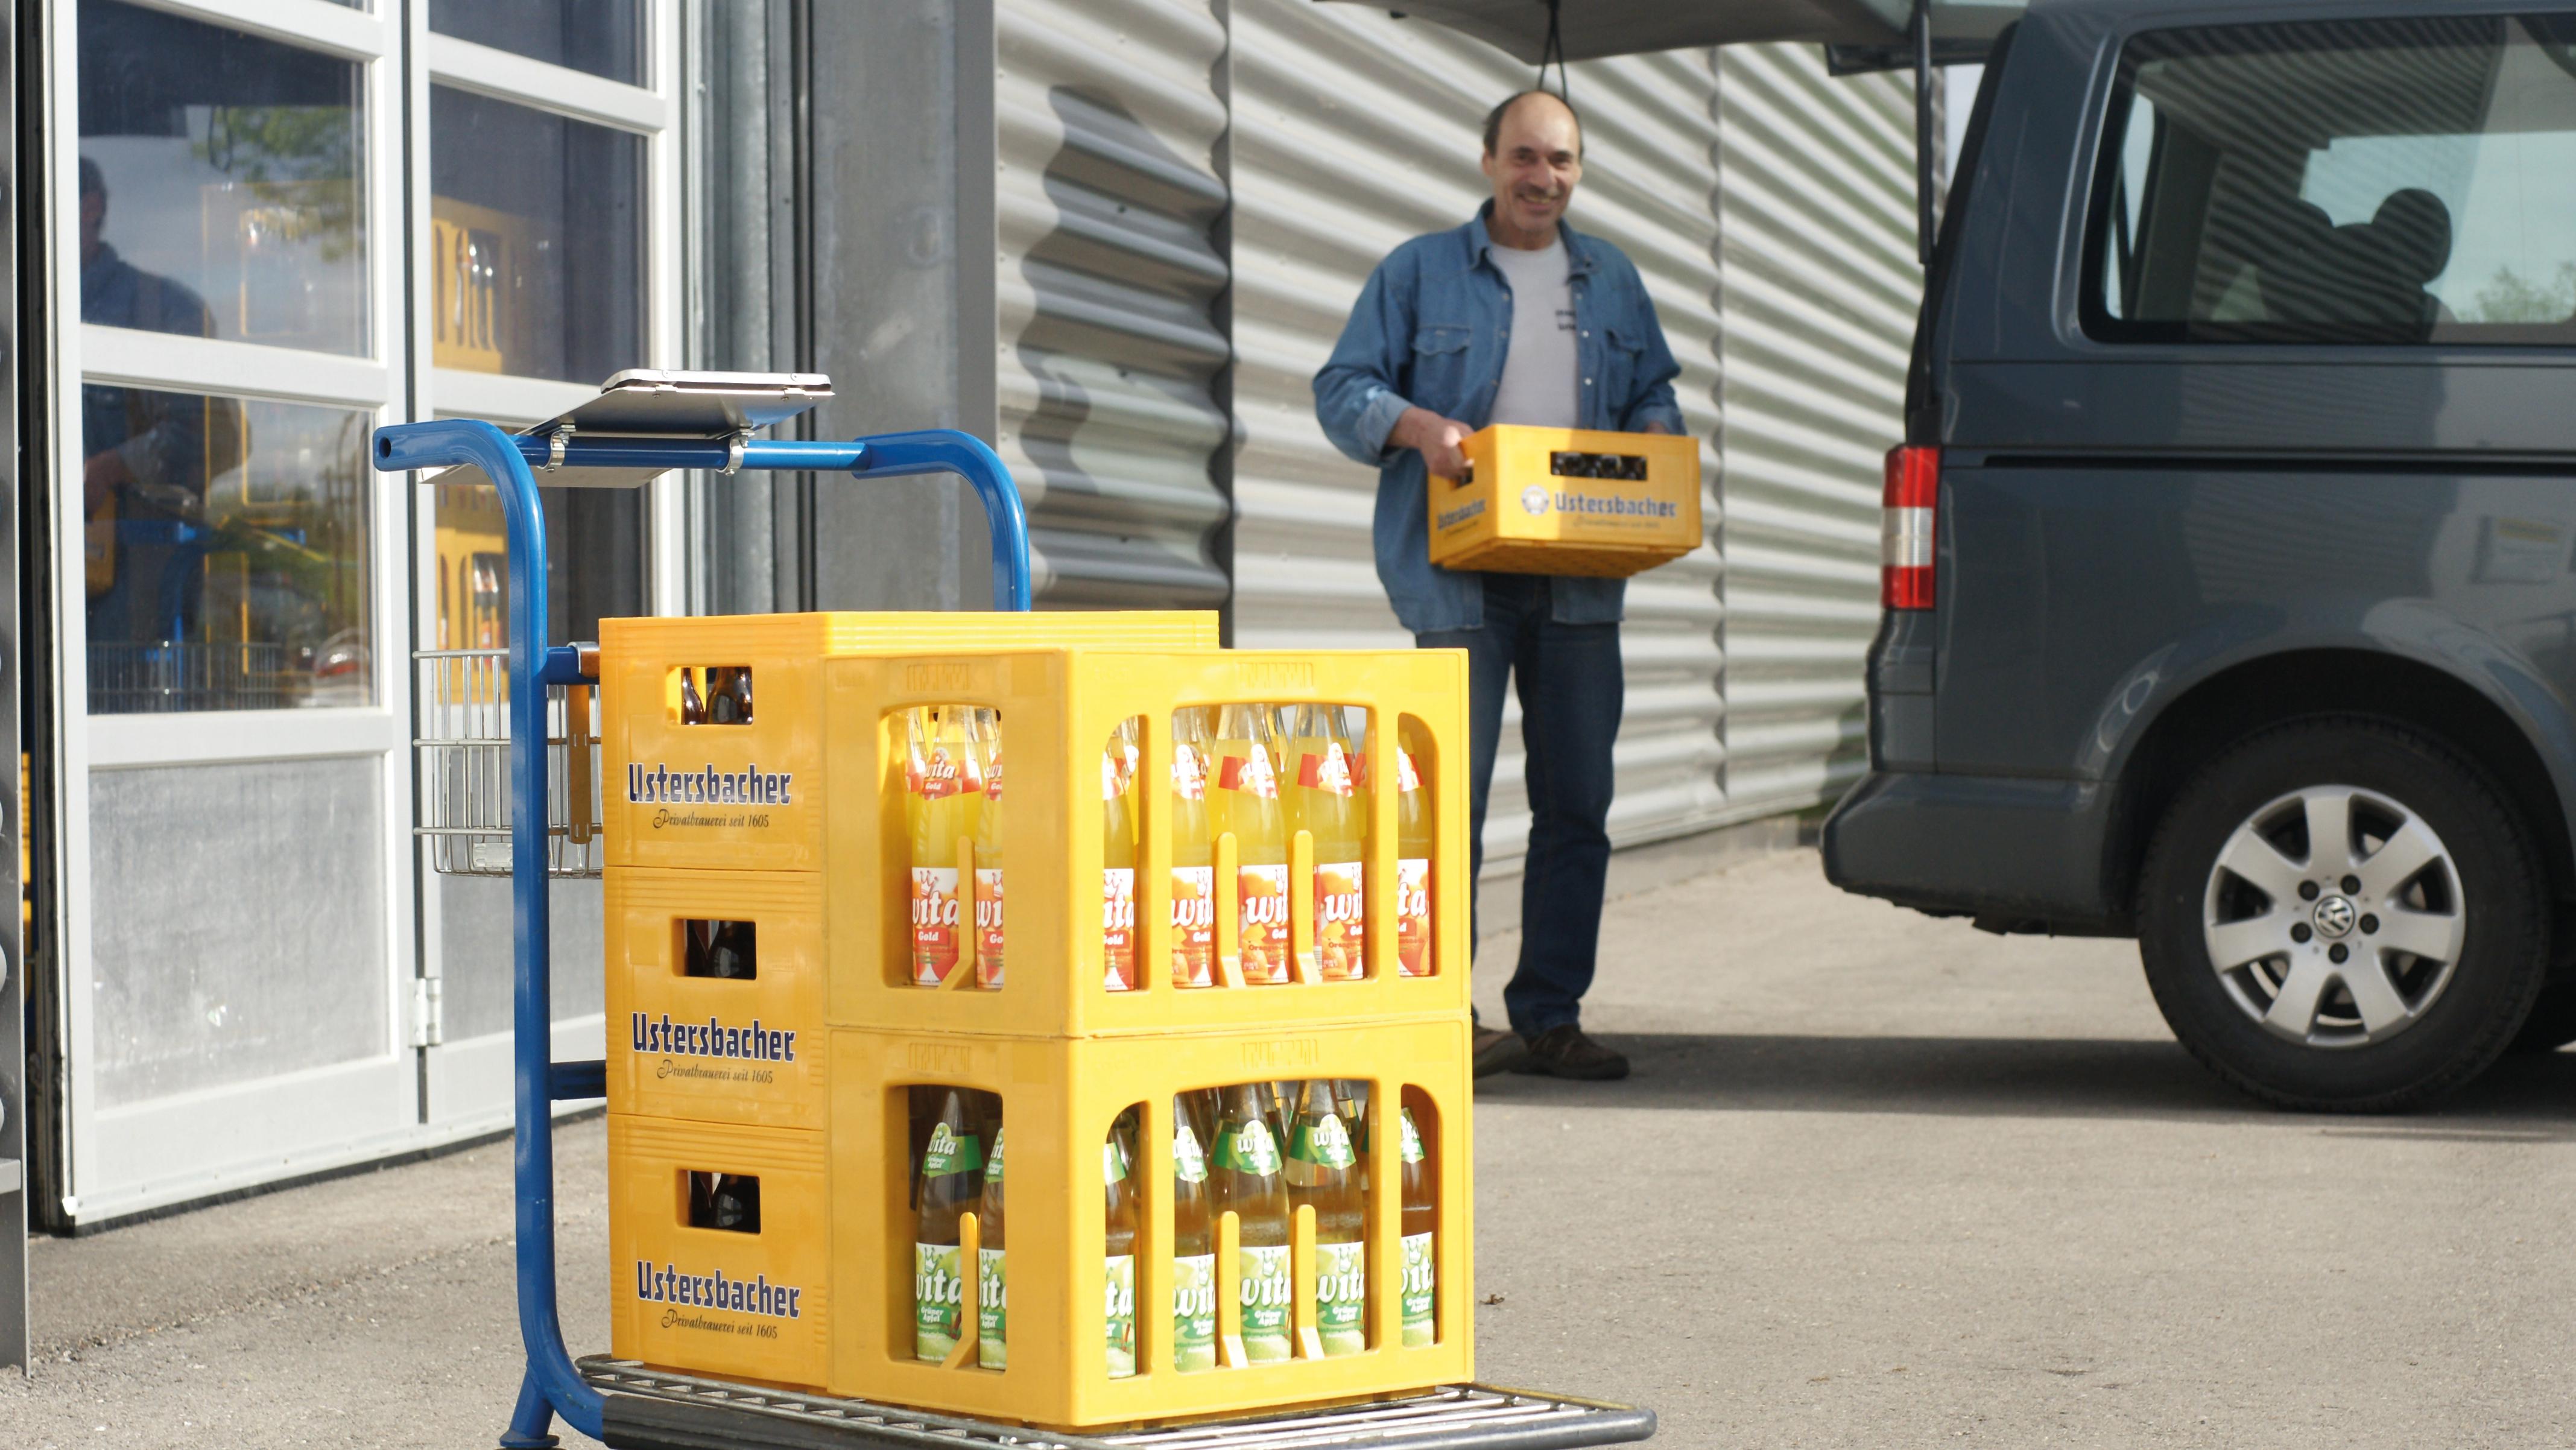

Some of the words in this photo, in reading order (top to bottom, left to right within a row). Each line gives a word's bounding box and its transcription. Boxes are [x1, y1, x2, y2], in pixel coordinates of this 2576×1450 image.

[1554, 492, 1677, 518] Ustersbacher
[628, 762, 793, 805] Ustersbacher
[653, 809, 727, 829] Privatbrauerei
[729, 815, 745, 827] seit
[748, 814, 769, 828] 1605
[976, 901, 1003, 927] wi
[1104, 893, 1134, 928] ita
[1398, 882, 1427, 917] ta
[918, 931, 939, 941] Gold
[990, 934, 1003, 943] Go
[632, 1012, 796, 1062] Ustersbacher
[657, 1059, 730, 1080] Privatbrauerei
[733, 1069, 749, 1081] seit
[752, 1069, 773, 1084] 1605
[637, 1260, 800, 1319] Ustersbacher
[979, 1274, 1007, 1309] it
[1106, 1281, 1133, 1317] ta
[1174, 1279, 1214, 1317] wit
[661, 1309, 735, 1334] Privatbrauerei
[737, 1322, 753, 1335] seit
[756, 1323, 777, 1339] 1605
